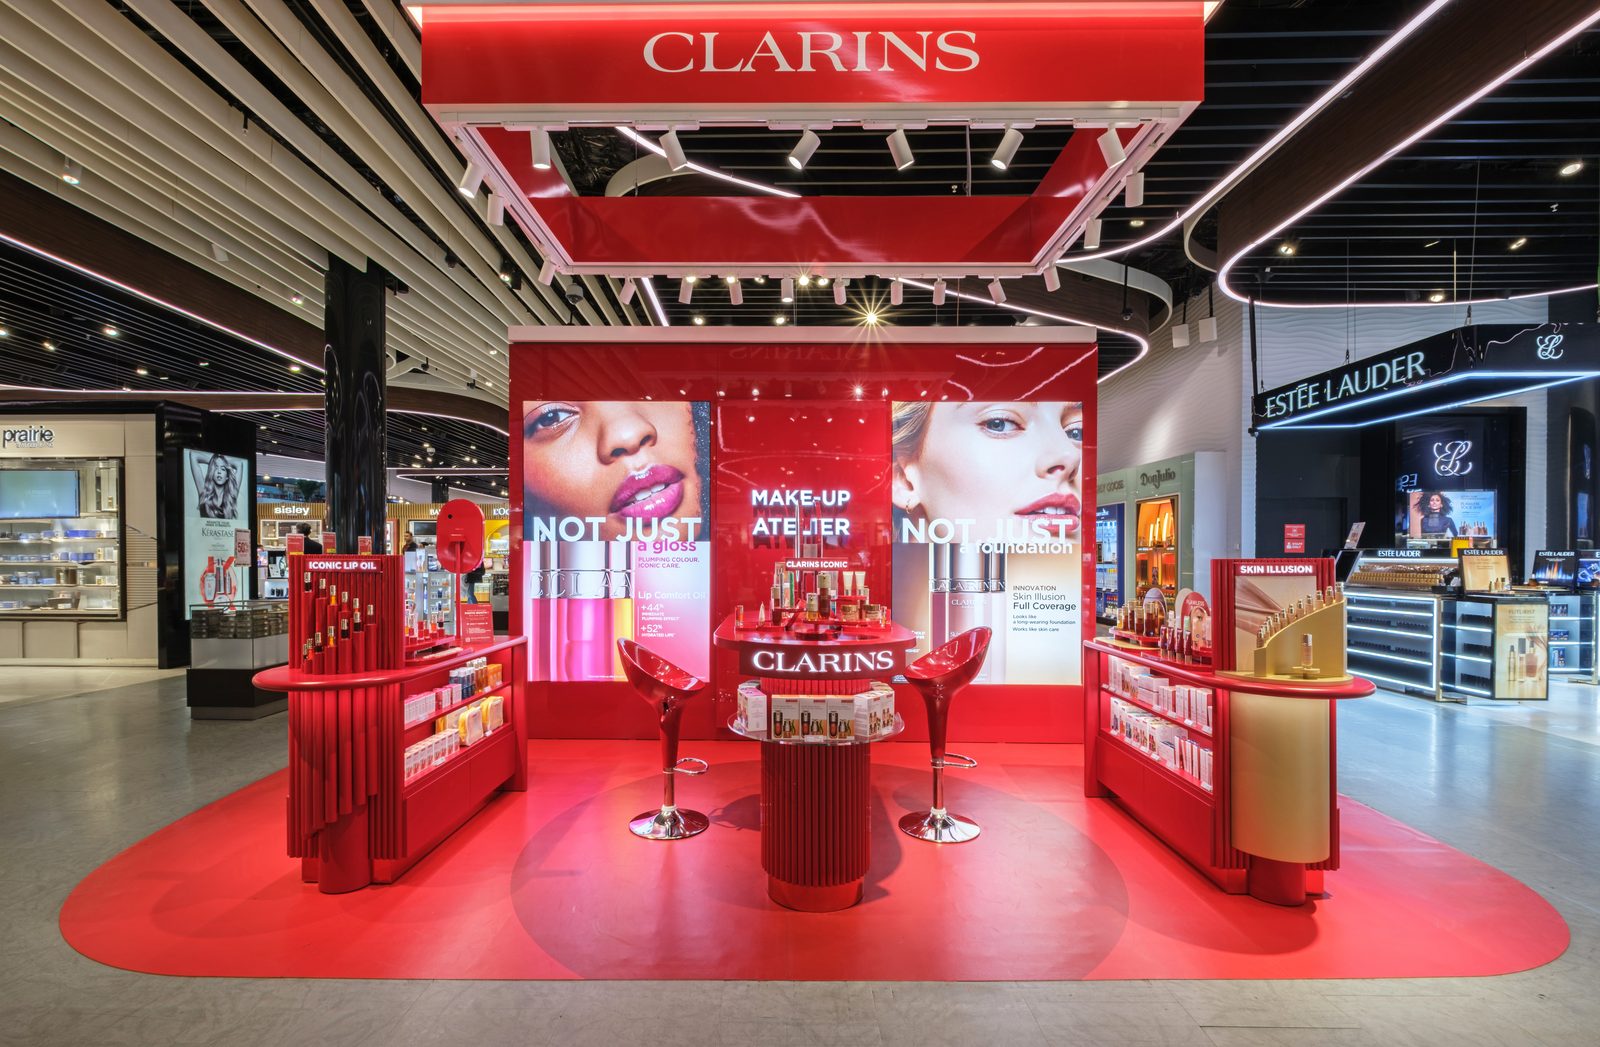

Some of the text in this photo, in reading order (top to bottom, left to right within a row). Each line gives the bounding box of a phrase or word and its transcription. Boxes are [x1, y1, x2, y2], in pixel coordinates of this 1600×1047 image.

[643, 30, 980, 73] CLARINS
[1266, 351, 1426, 418] ESTÉE LAUDER
[3, 425, 54, 449] prairie
[751, 489, 851, 506] MAKE-UP
[274, 505, 310, 516] sisley
[533, 516, 702, 542] NOT JUST
[902, 518, 1073, 544] NOT JUST
[638, 538, 697, 553] a gloss
[960, 539, 1073, 554] a foundation
[309, 561, 377, 570] ICONIC LIP OIL
[1240, 565, 1313, 574] SKIN ILLUSION
[638, 591, 652, 600] Lip
[654, 591, 690, 599] Comfort
[1013, 592, 1066, 601] Skin Illusion
[1013, 602, 1077, 612] Full Coverage
[753, 650, 894, 673] CLARINS
